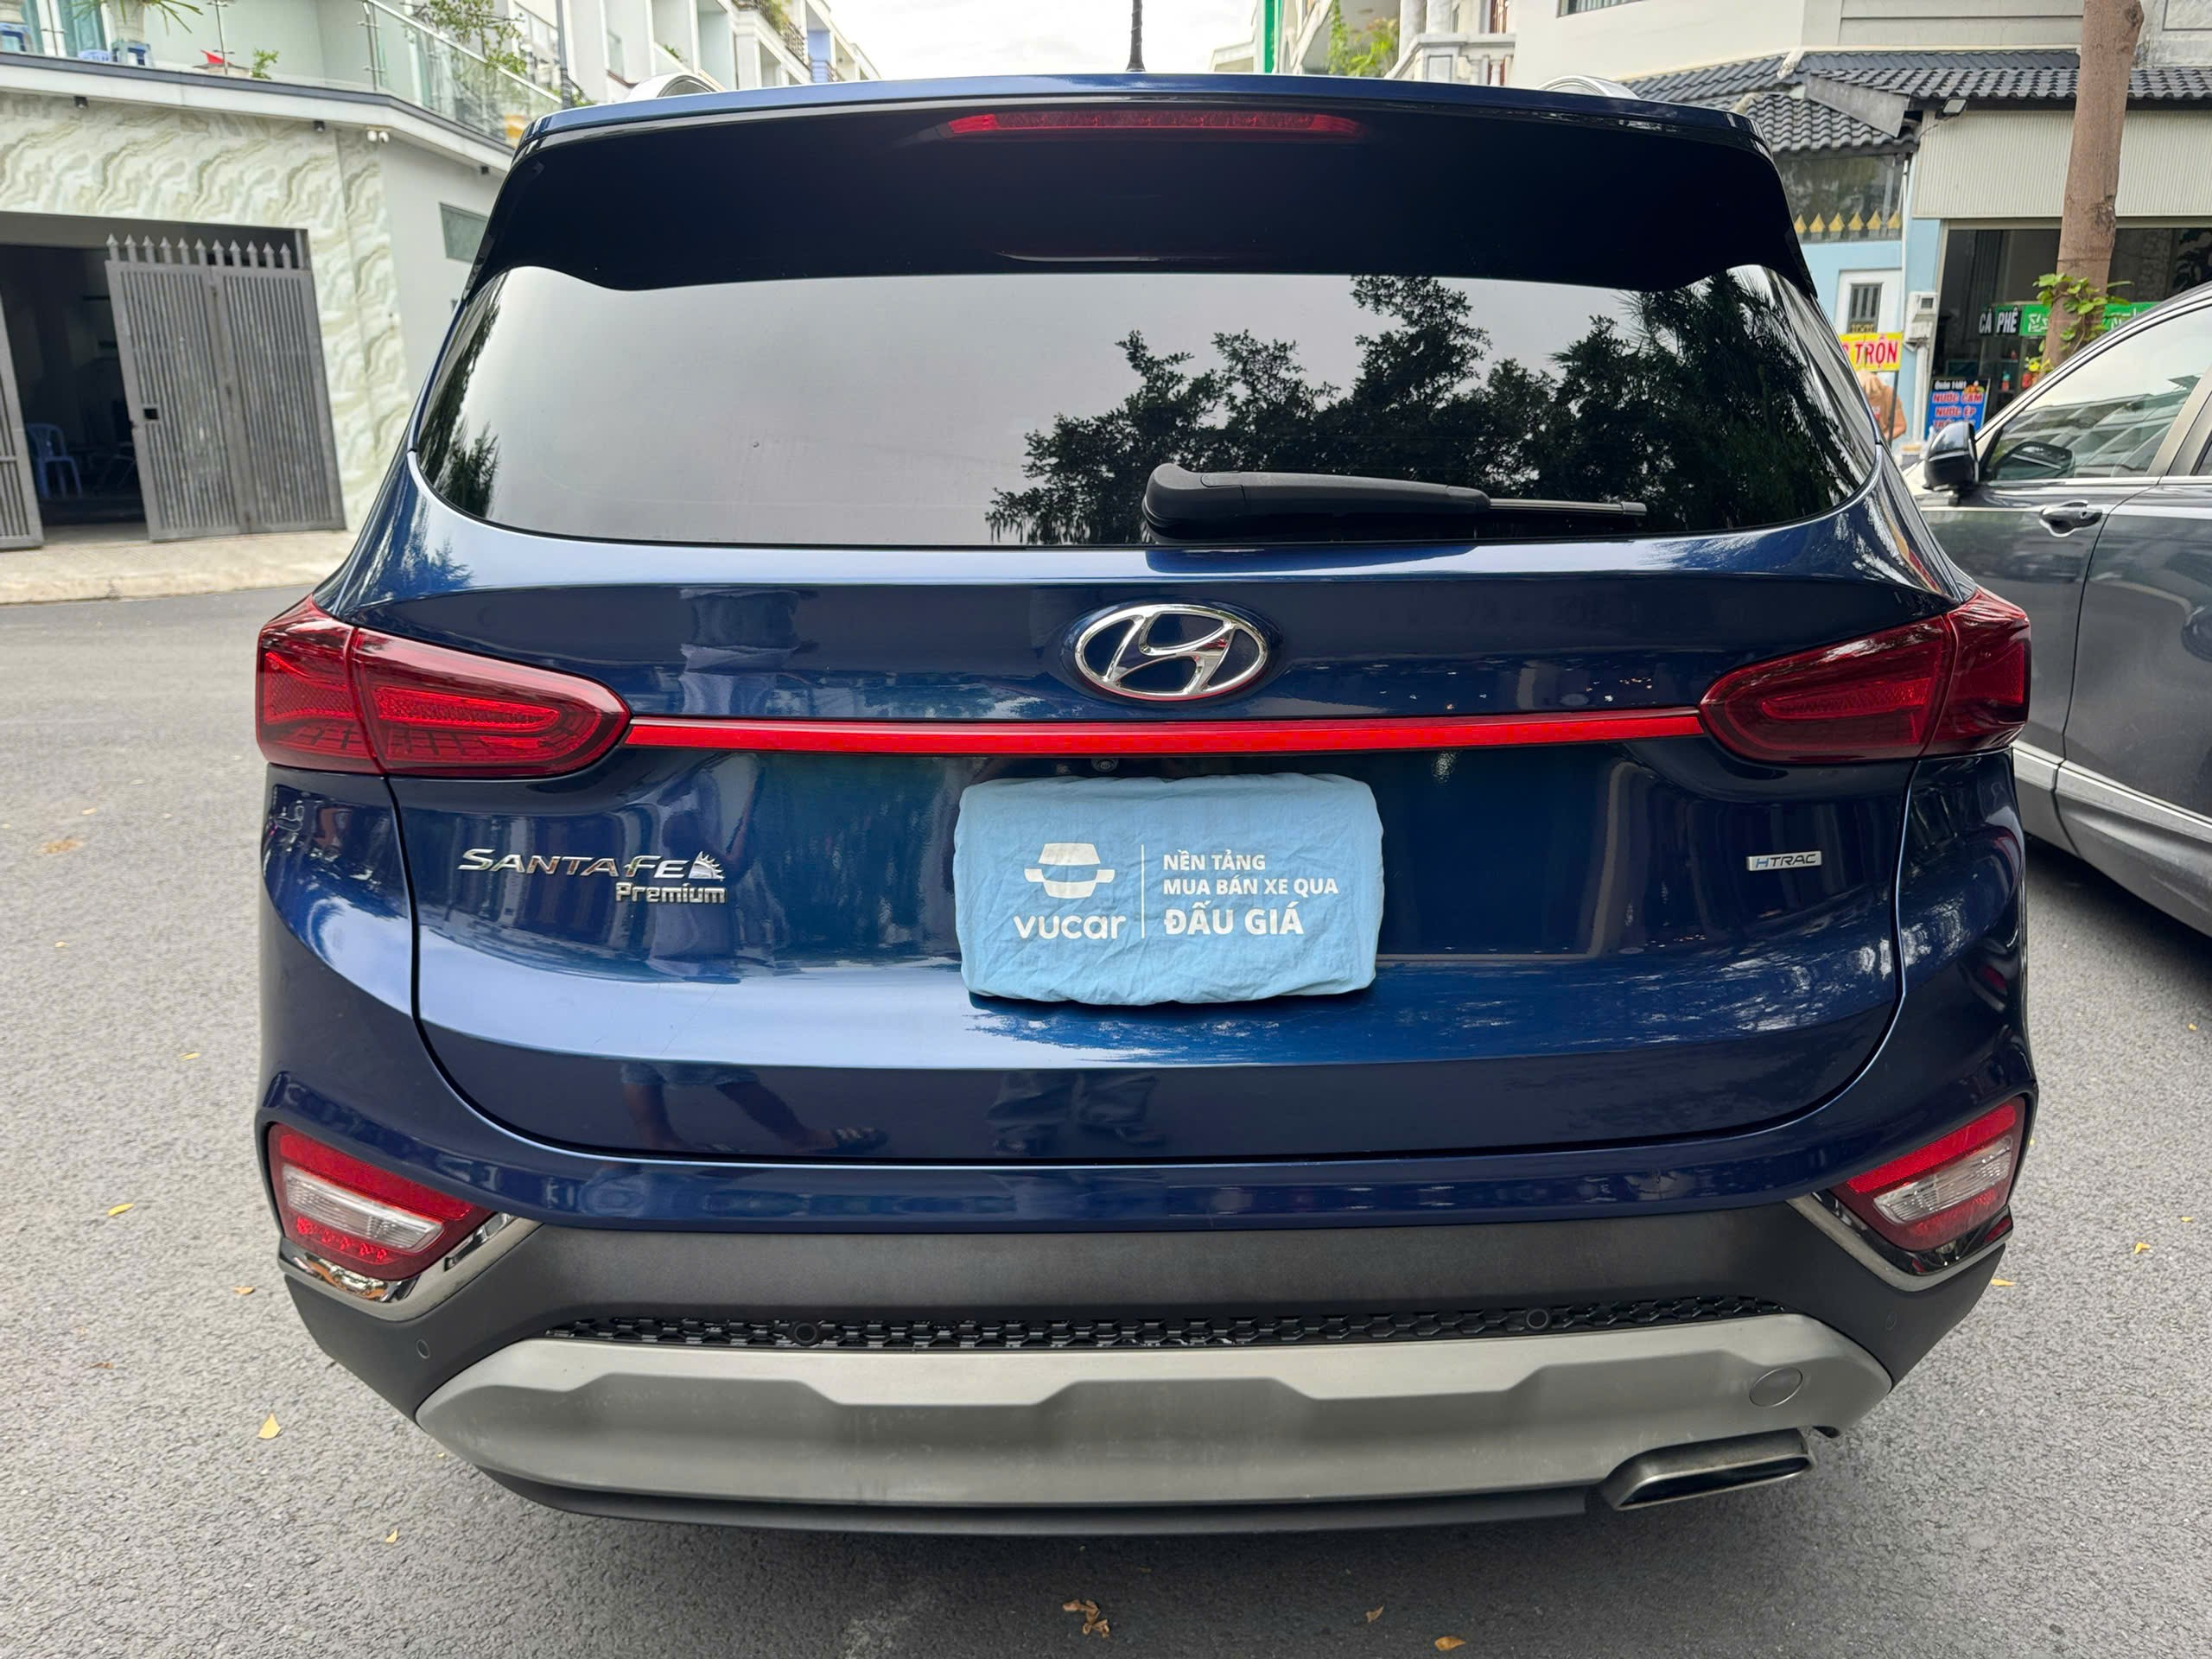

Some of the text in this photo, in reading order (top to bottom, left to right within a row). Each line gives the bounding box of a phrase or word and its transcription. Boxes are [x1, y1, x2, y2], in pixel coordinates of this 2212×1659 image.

[1979, 308, 1993, 334] CÀ
[1996, 306, 2018, 334] PHÊ
[1854, 334, 1898, 369] TRỘN
[1163, 849, 1267, 871] NỀN TẢNG
[1755, 854, 1816, 868] HTRAC
[615, 881, 727, 904] Premium
[1163, 874, 1338, 897] MUA BÁN XE QUA
[1013, 913, 1127, 940] vucar
[1164, 900, 1305, 936] ĐẤU GIÁ
